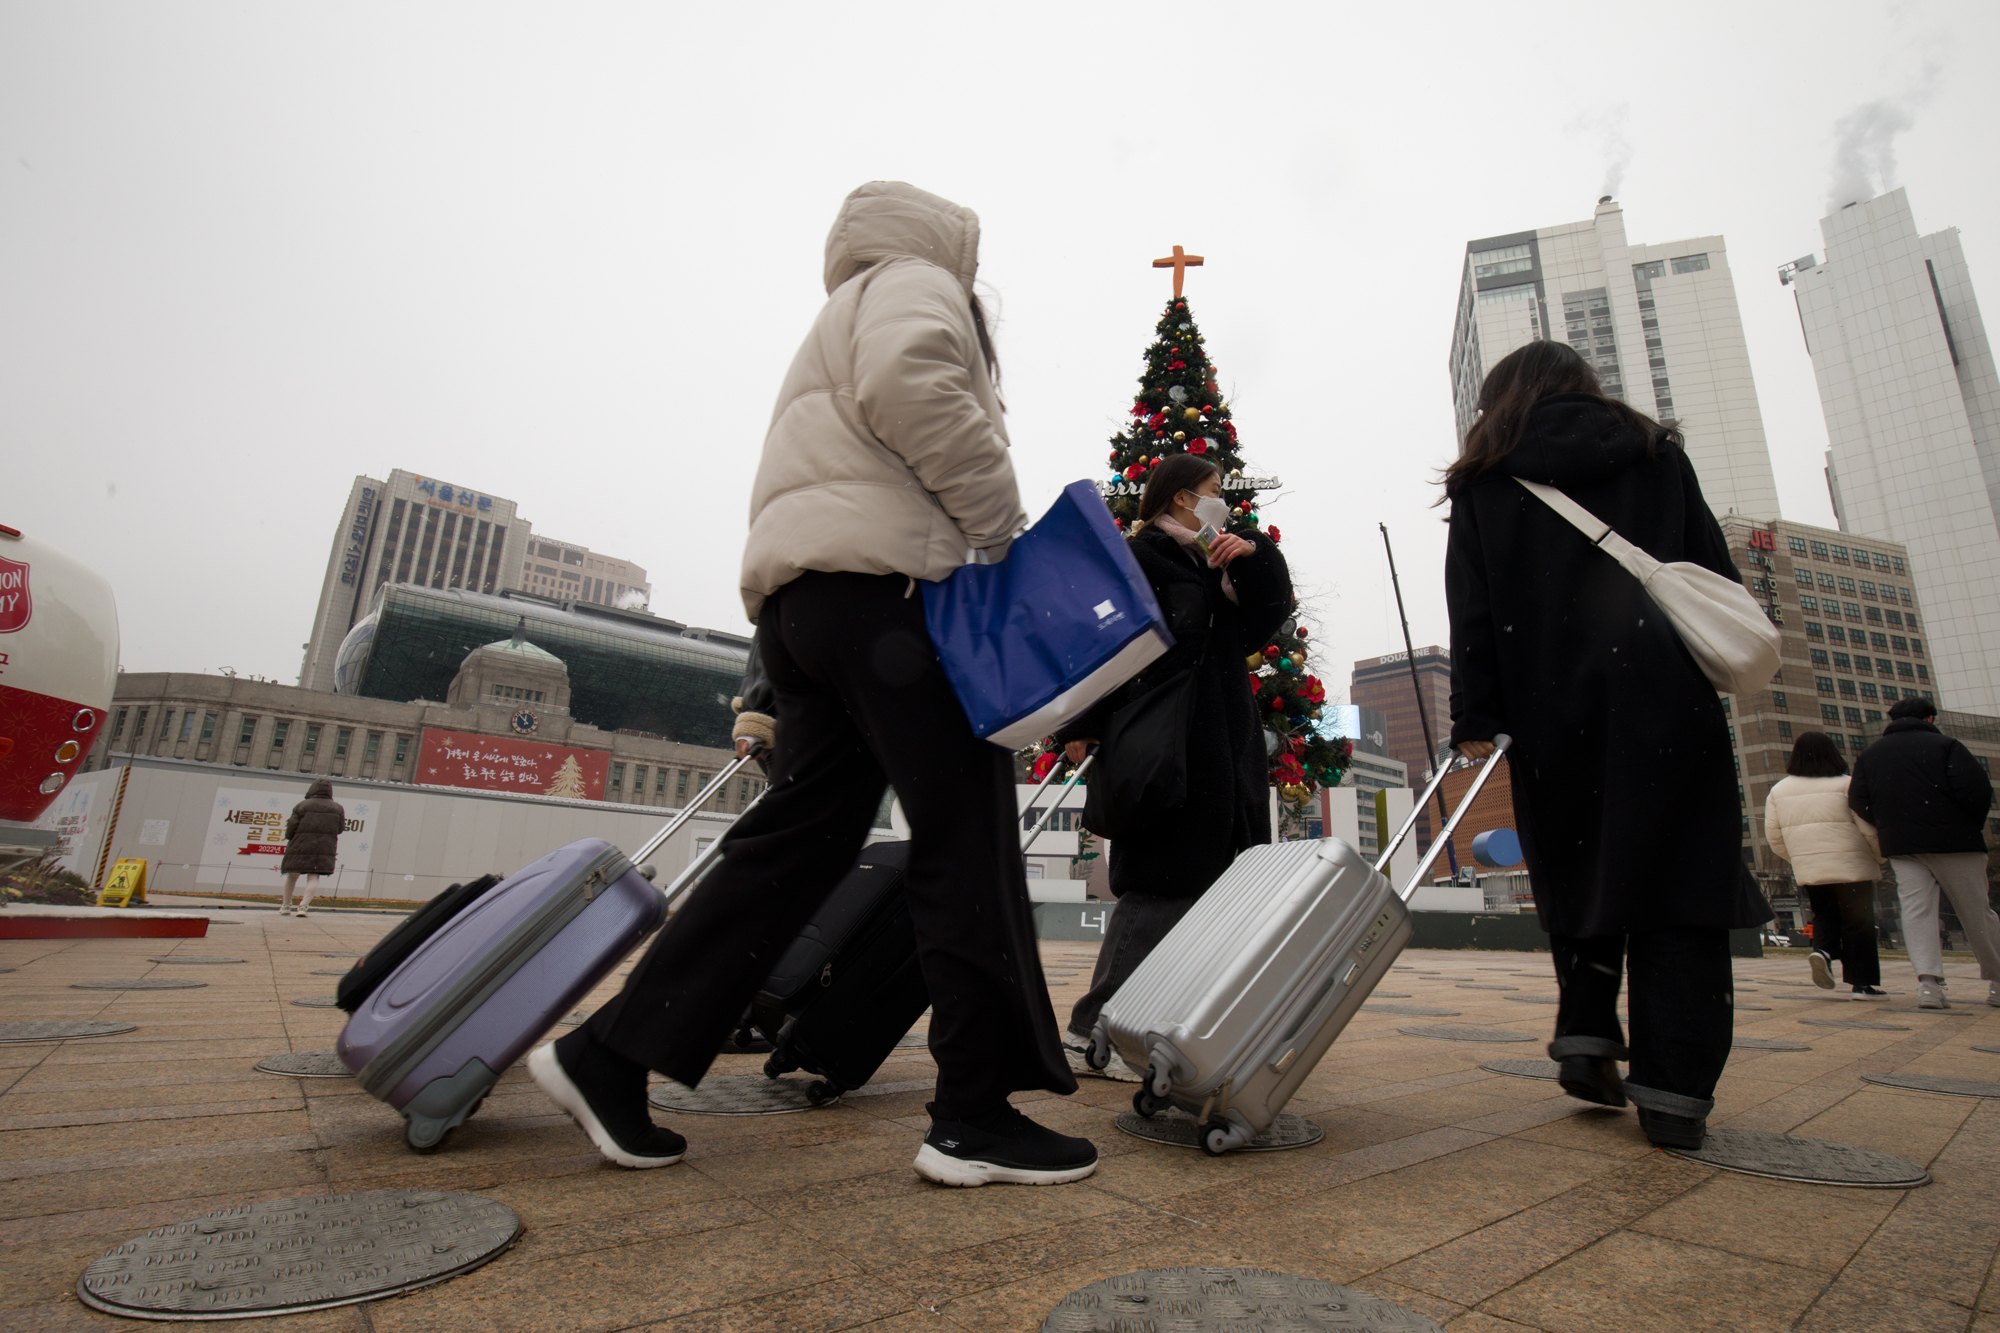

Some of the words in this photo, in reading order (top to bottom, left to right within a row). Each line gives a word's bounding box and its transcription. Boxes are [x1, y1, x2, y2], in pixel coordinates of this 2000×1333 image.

[418, 480, 493, 513] 서울신문
[341, 487, 376, 587] 한국프레스센터
[531, 534, 558, 547] FINANCE
[559, 541, 582, 551] CENTER
[1749, 529, 1777, 551] JEI
[1763, 556, 1785, 625] 재능교육
[1380, 647, 1430, 664] DOUZNE
[445, 747, 470, 760] 겨울이
[472, 750, 480, 761] 온
[482, 753, 508, 764] 세상에
[463, 763, 478, 780] 홀로
[480, 767, 496, 780] 추운
[500, 769, 515, 782] 삶은
[224, 809, 282, 827] 서울광장
[247, 826, 263, 841] 곧
[267, 827, 287, 842] 공
[258, 845, 281, 854] 2022년
